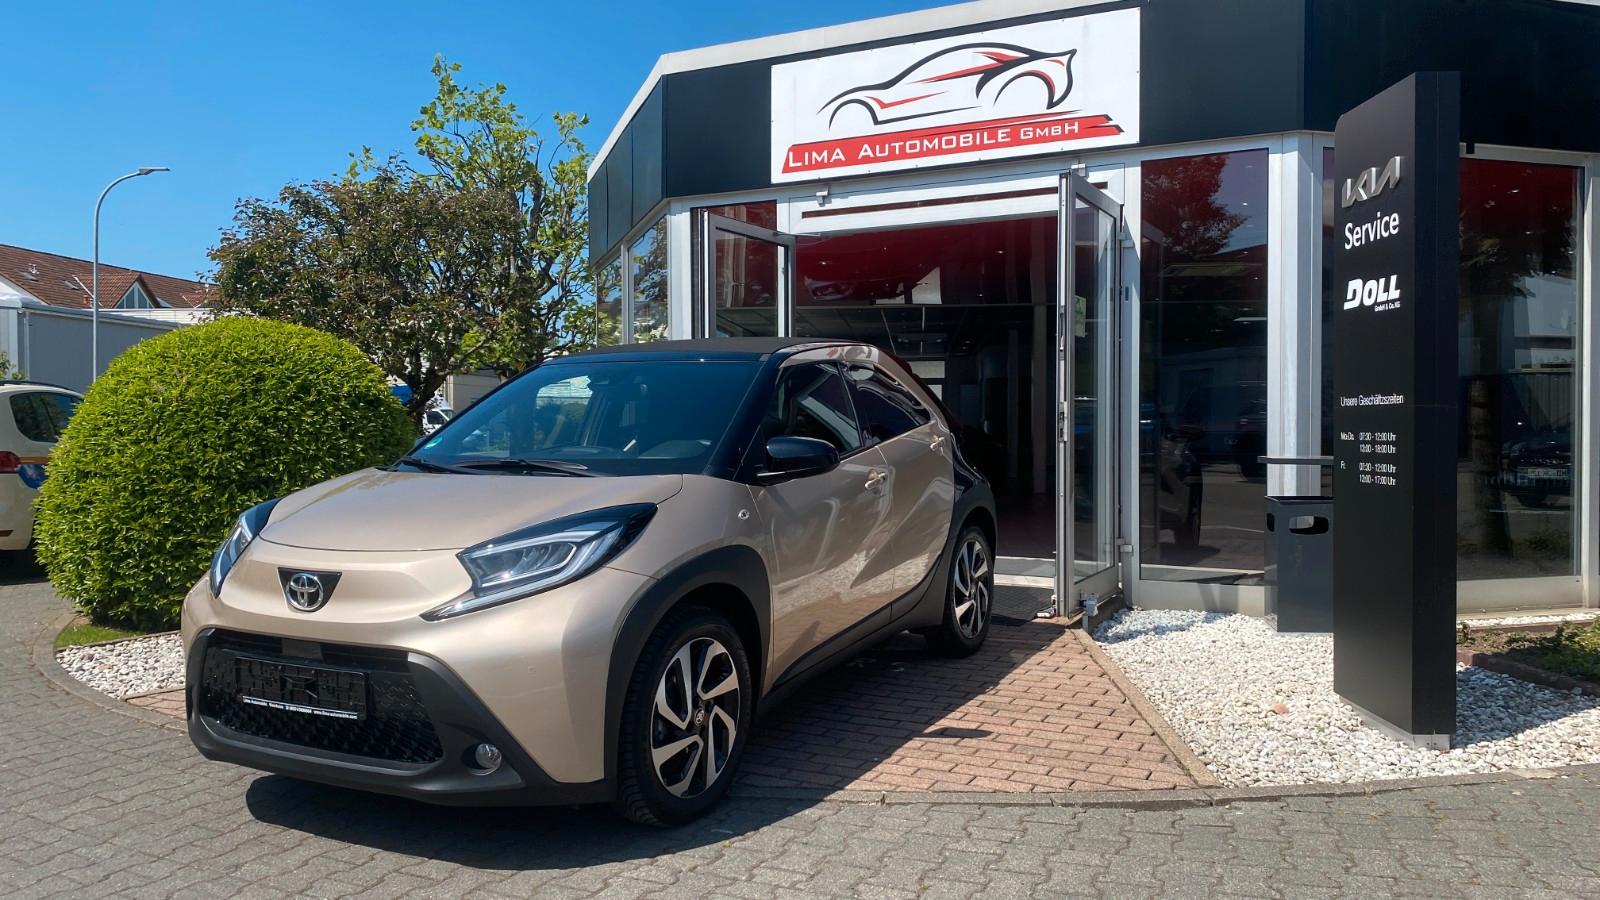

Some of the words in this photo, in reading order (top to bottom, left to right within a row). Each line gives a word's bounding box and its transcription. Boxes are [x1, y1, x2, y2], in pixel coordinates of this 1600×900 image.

[1344, 211, 1400, 250] Service
[1343, 274, 1401, 310] DOLL
[1340, 396, 1358, 407] Unsere
[1358, 393, 1404, 406] Geschäftszeiten
[1388, 432, 1397, 441] Uhr
[1388, 444, 1397, 454] Uhr
[1388, 463, 1397, 473] Uhr
[1388, 476, 1397, 486] Uhr
